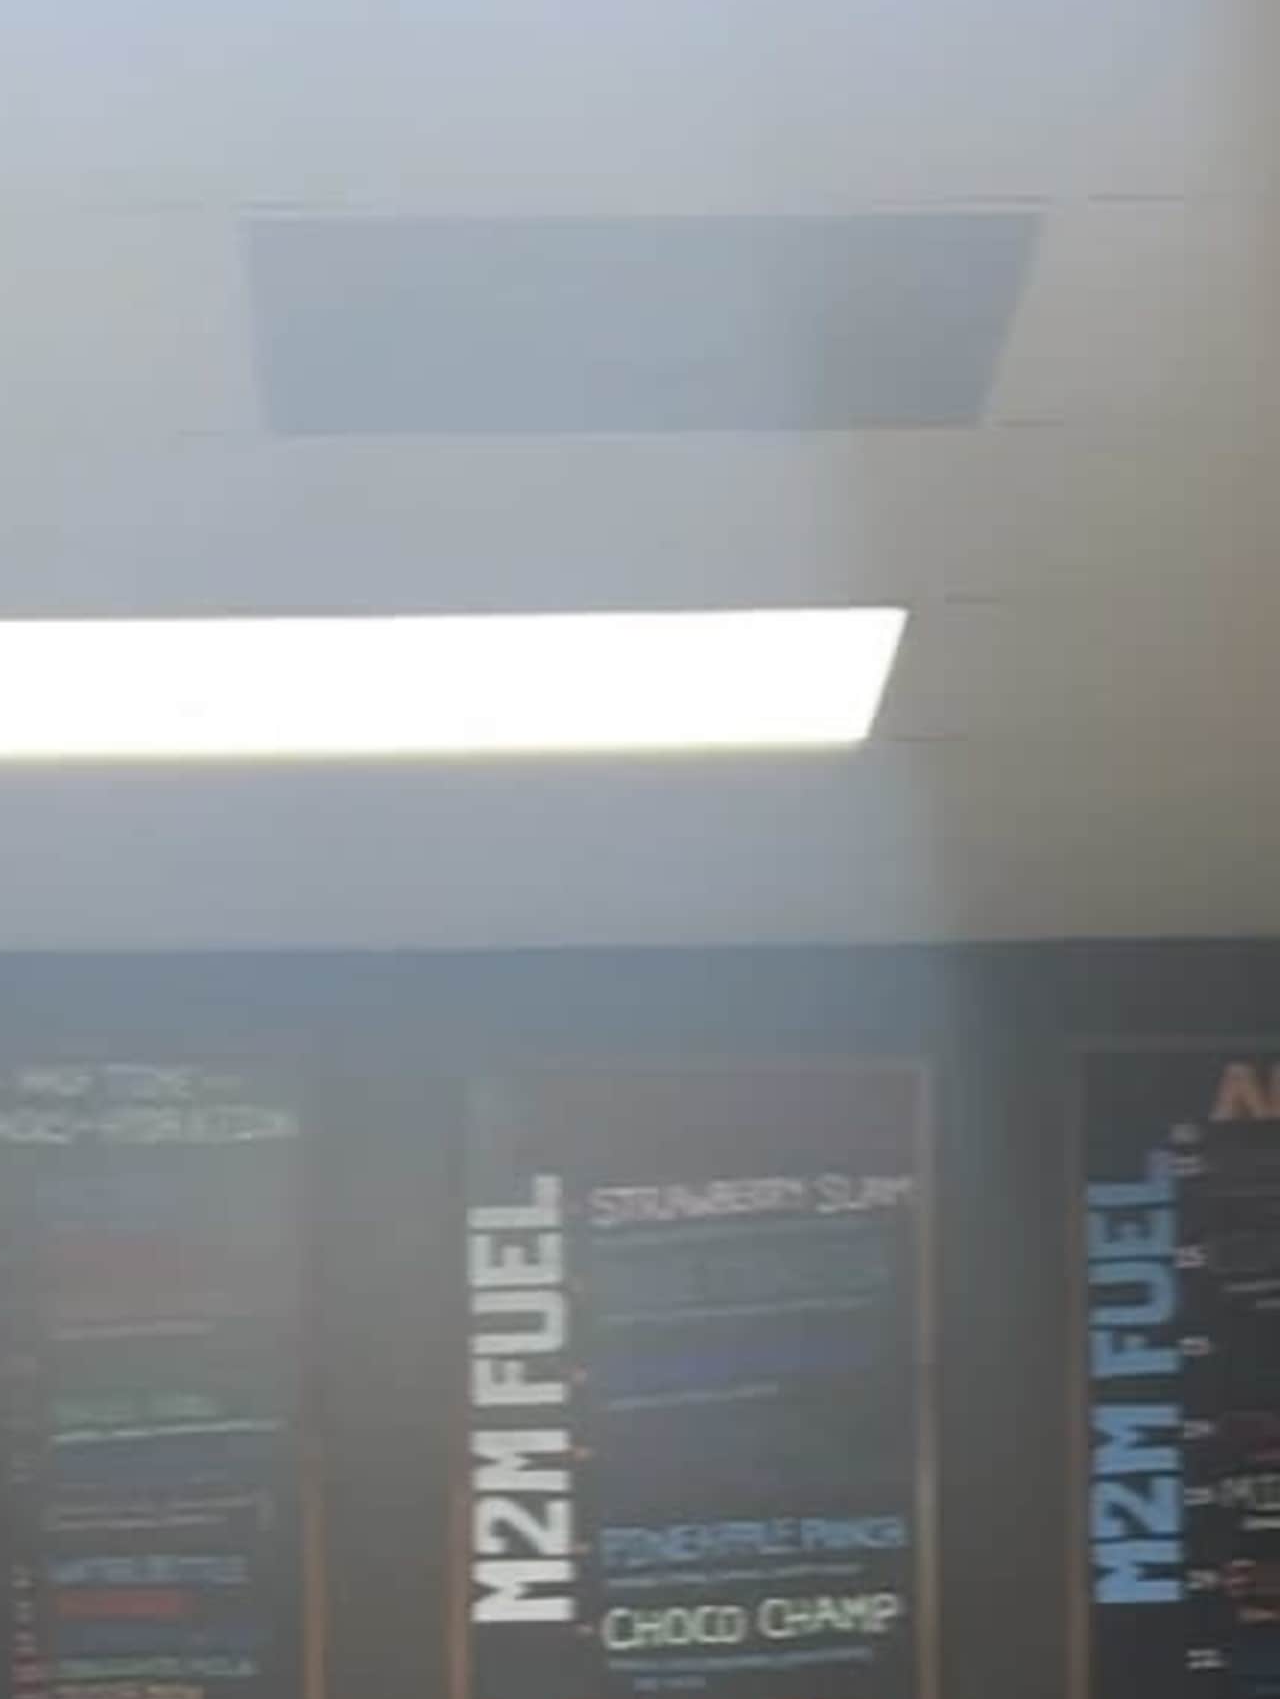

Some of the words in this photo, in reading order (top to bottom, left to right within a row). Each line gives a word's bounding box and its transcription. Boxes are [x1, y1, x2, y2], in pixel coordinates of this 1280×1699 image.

[467, 1173, 571, 1407] FUEL
[1086, 1146, 1182, 1381] FUEL
[470, 1428, 576, 1623] M2M
[1090, 1404, 1185, 1605] M2M
[601, 1603, 748, 1652] CHOCO
[756, 1591, 905, 1641] CHAMP
